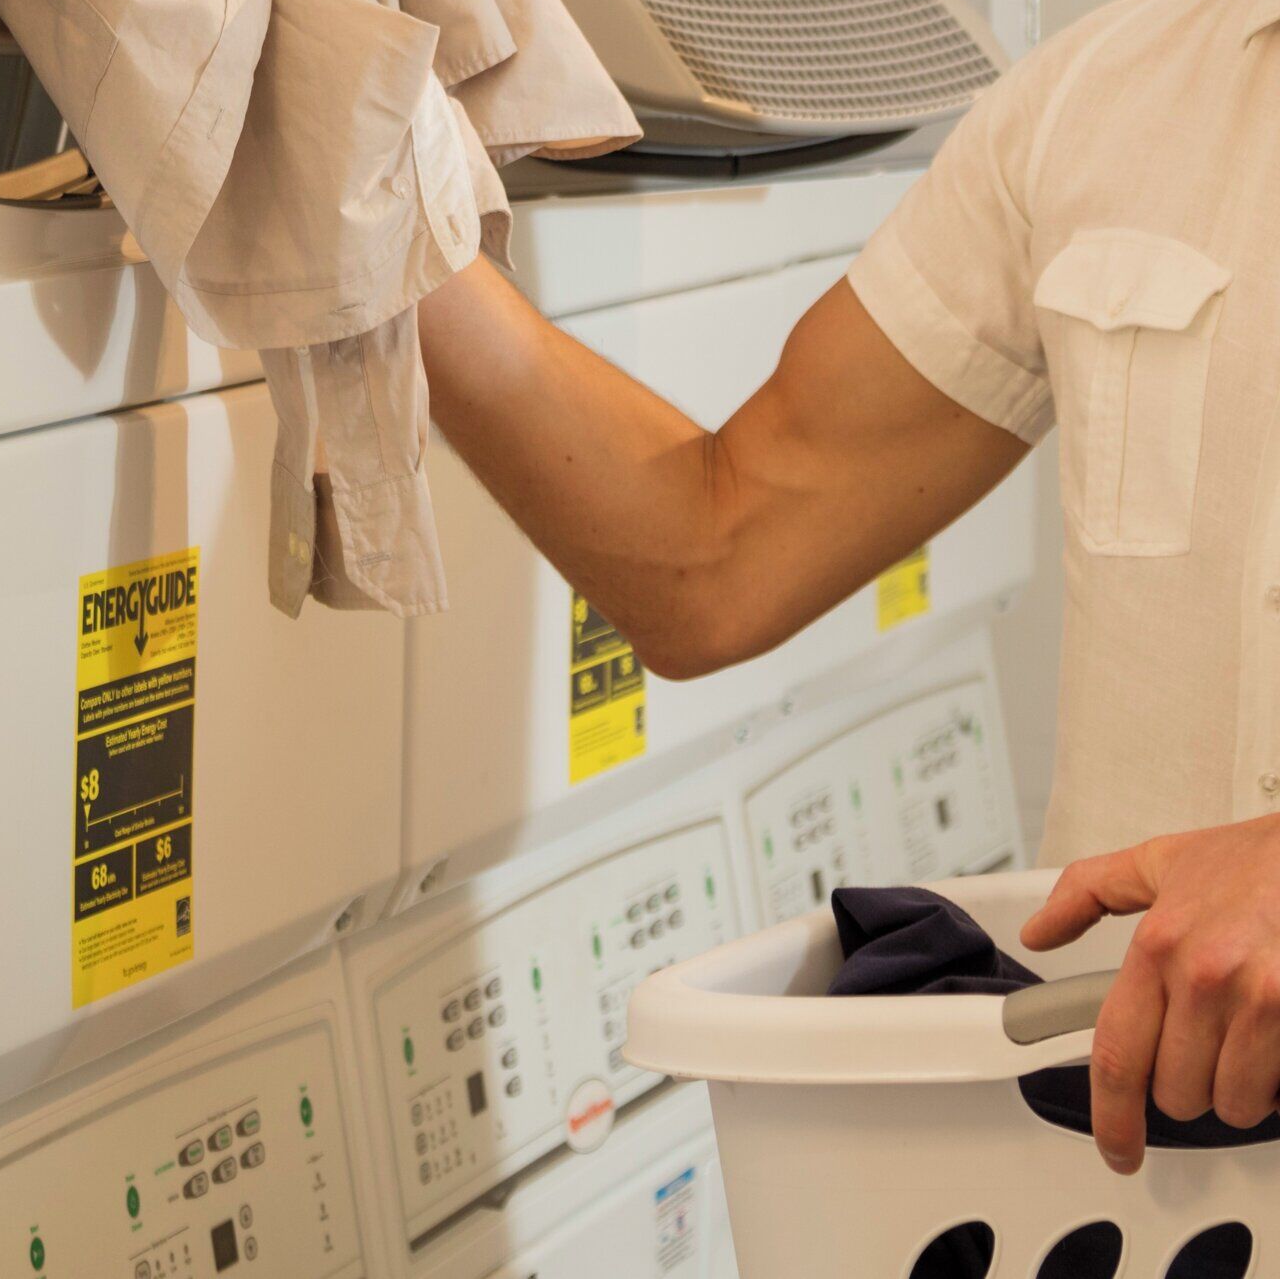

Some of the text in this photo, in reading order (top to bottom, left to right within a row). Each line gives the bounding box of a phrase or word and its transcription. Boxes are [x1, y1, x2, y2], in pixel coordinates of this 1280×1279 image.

[82, 566, 197, 634] ENERGYGUIDE
[80, 768, 100, 802] $8
[156, 835, 172, 863] $6
[91, 863, 108, 891] 68
